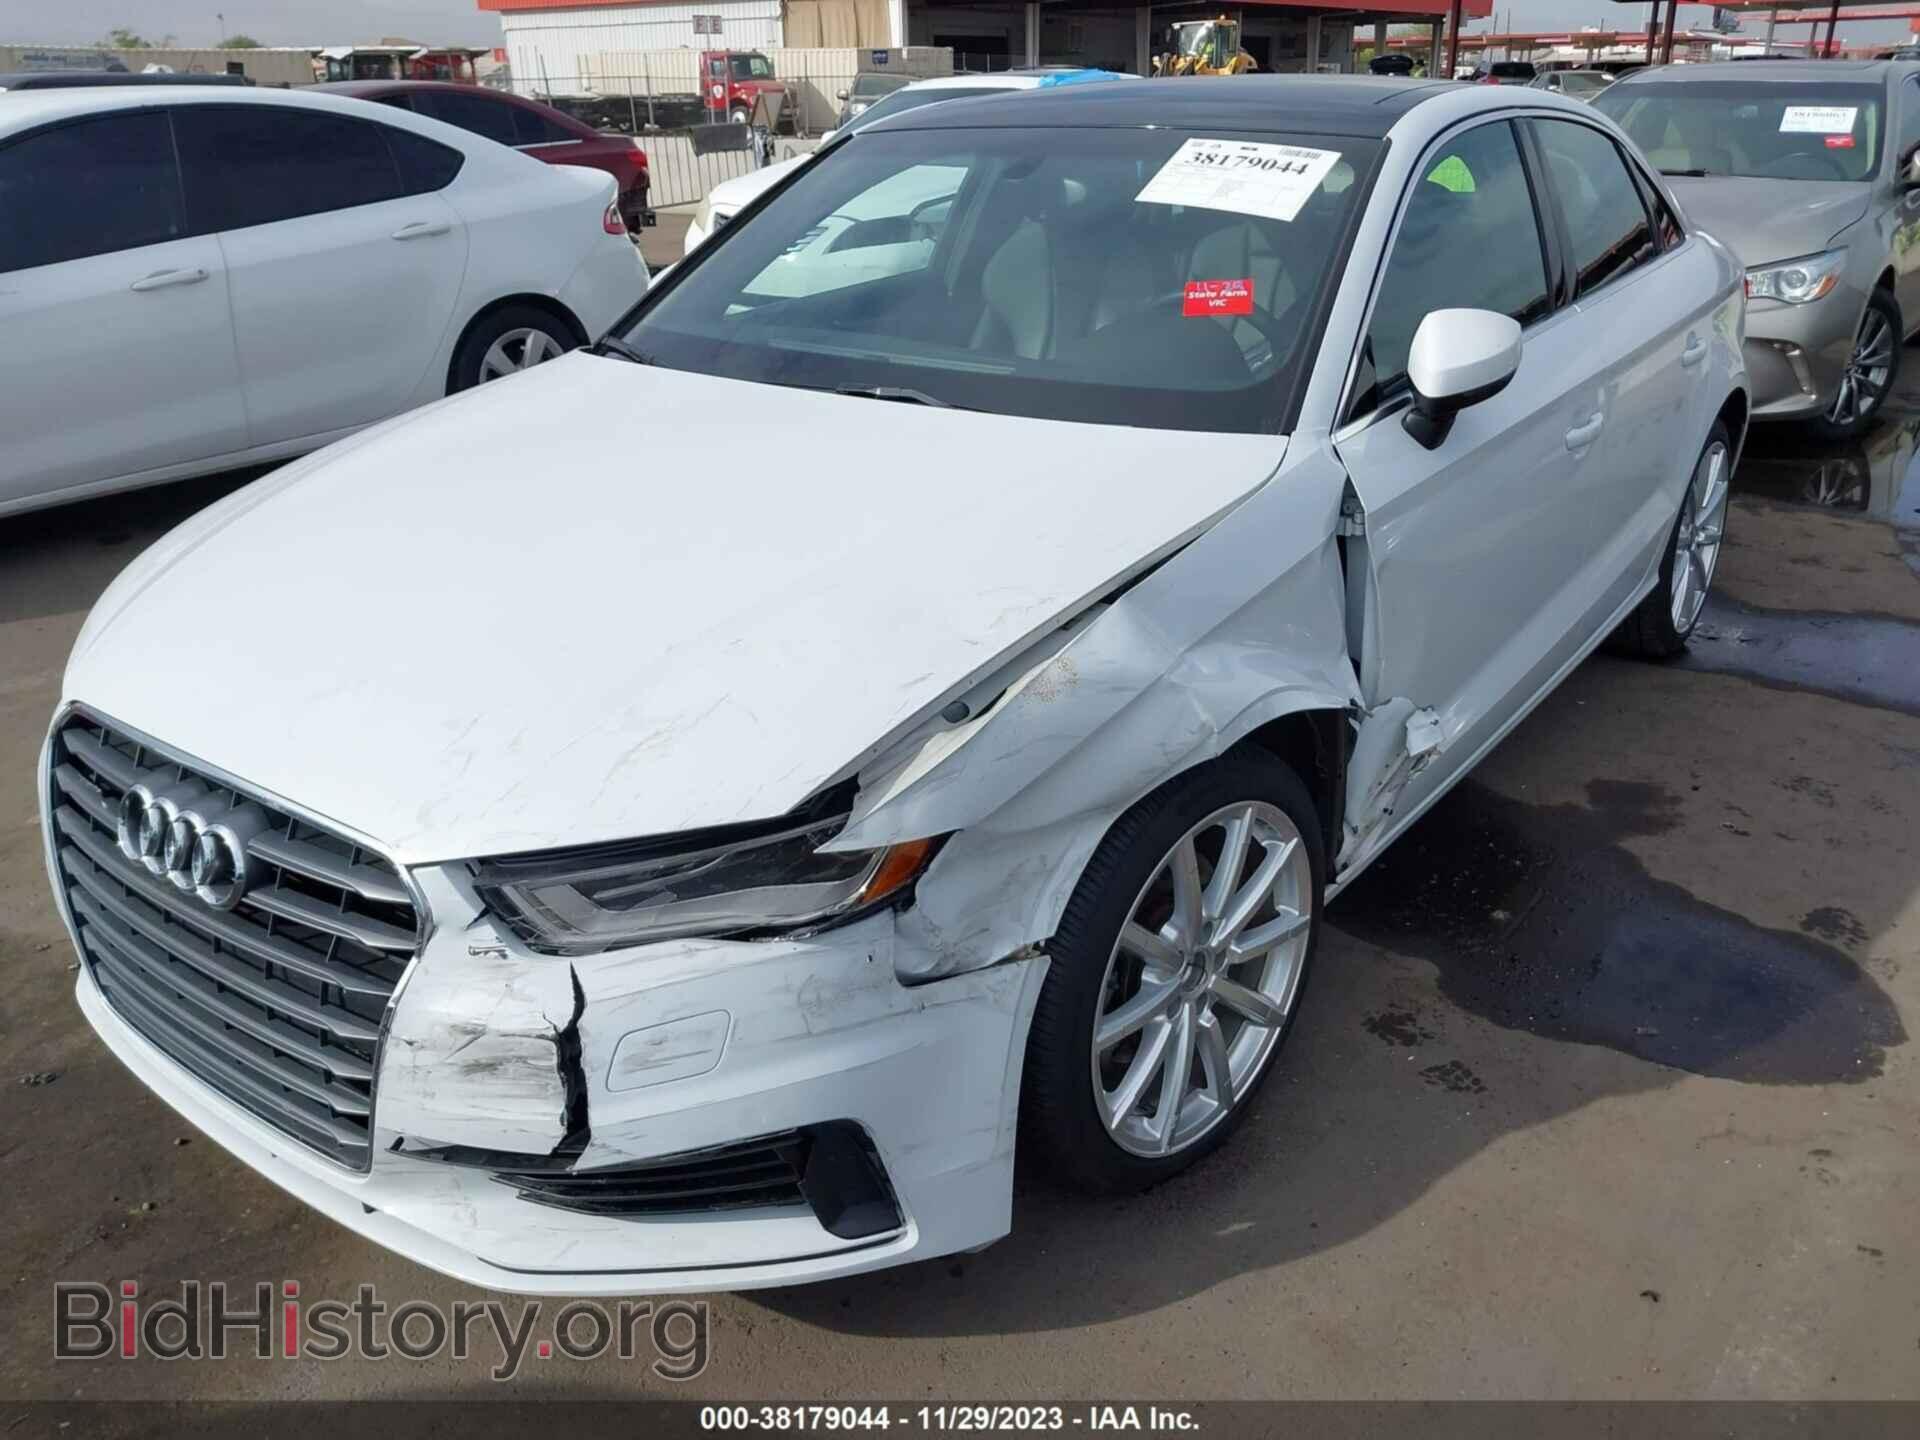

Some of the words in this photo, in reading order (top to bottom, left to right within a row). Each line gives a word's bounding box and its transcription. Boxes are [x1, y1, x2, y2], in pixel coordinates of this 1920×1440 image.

[1184, 151, 1309, 176] 38179044
[1188, 290, 1217, 300] State
[1219, 289, 1248, 298] Farm
